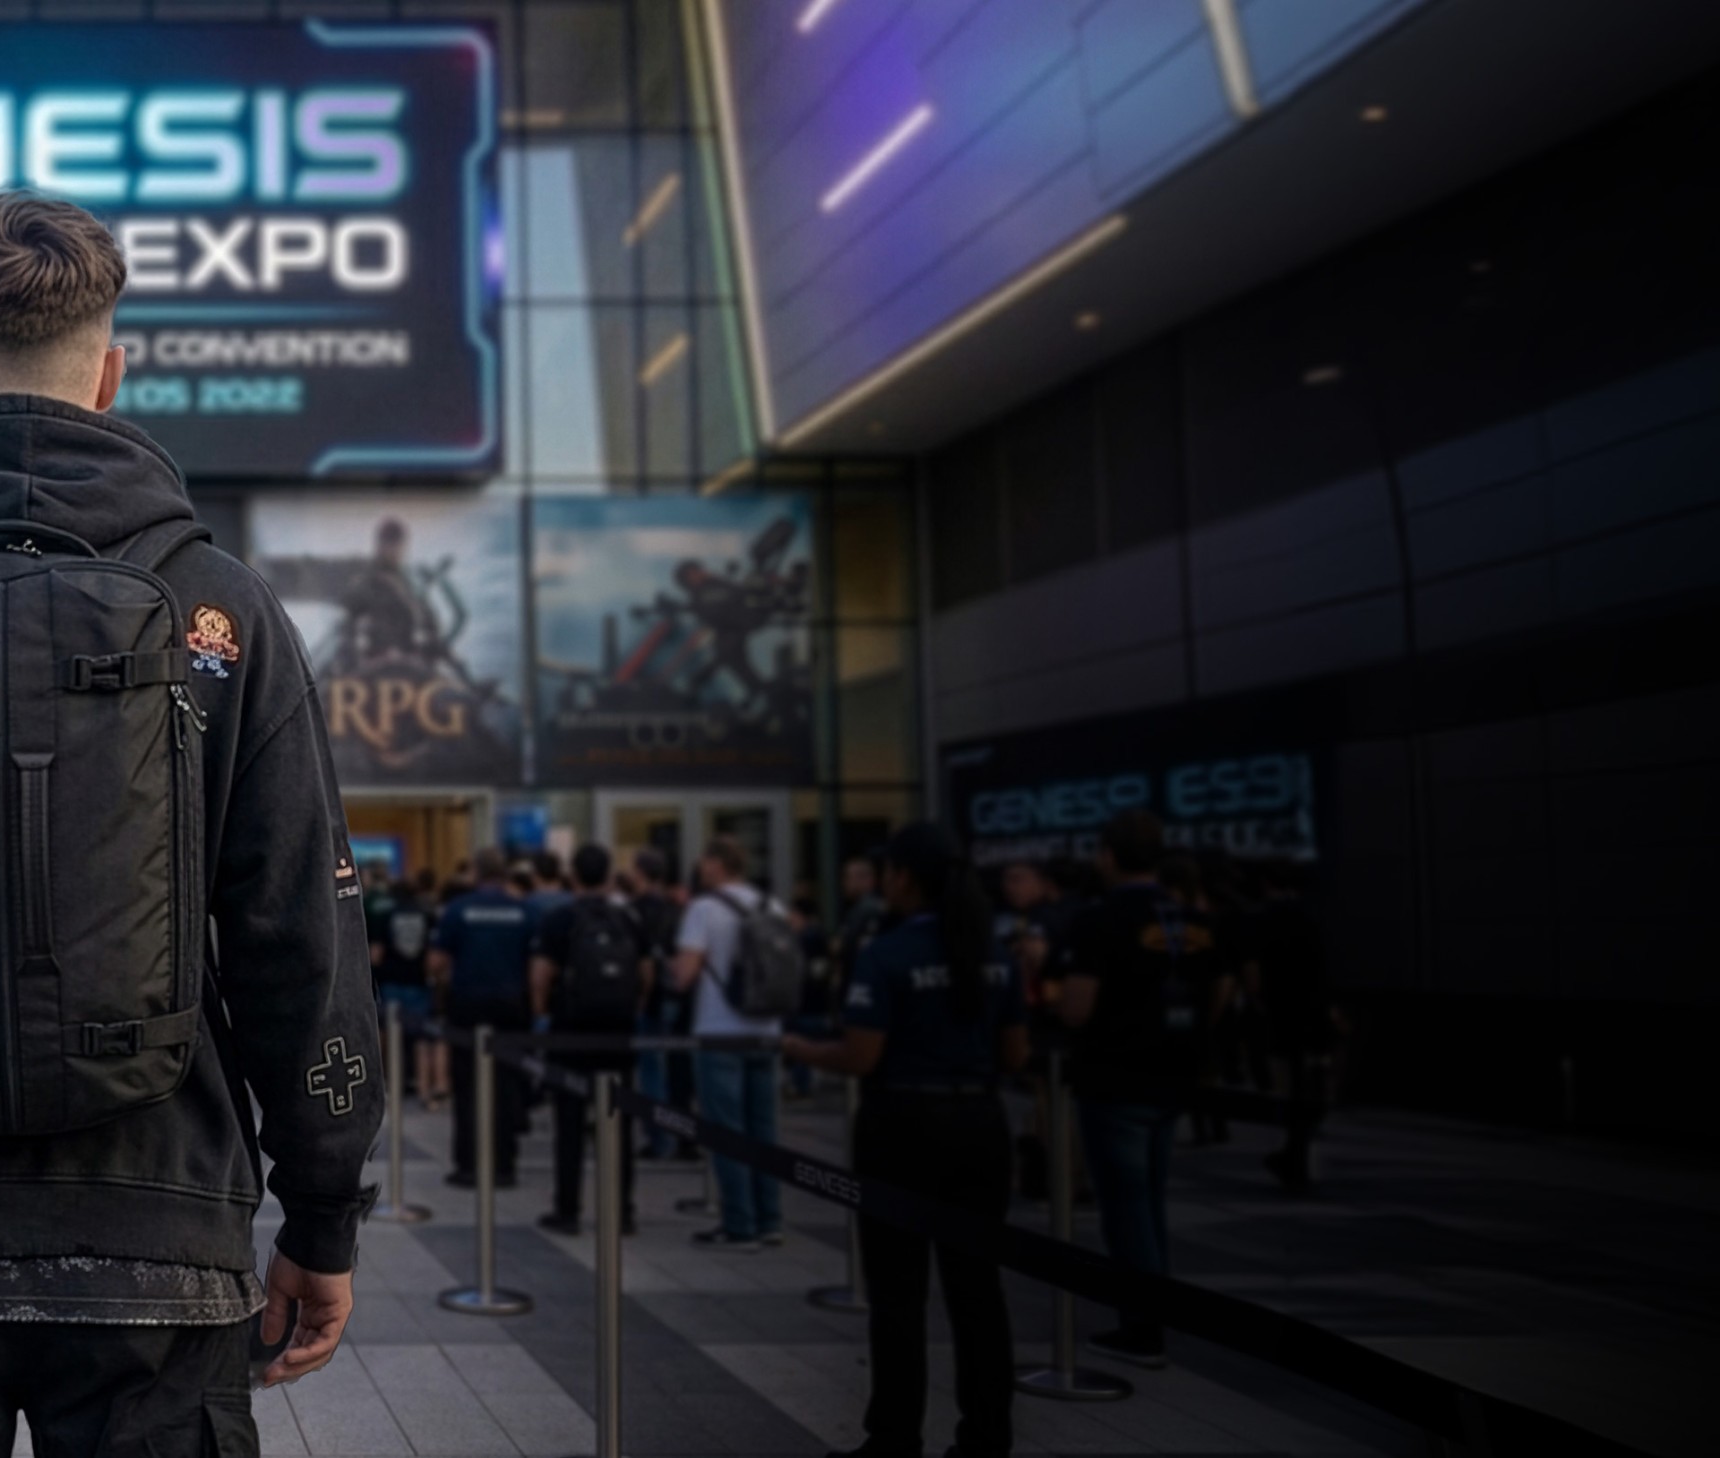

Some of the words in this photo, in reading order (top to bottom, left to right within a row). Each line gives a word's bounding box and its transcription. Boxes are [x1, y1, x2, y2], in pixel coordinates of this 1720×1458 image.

[122, 217, 407, 292] EXPO
[153, 331, 409, 369] CONVENTION
[329, 679, 464, 746] RPG
